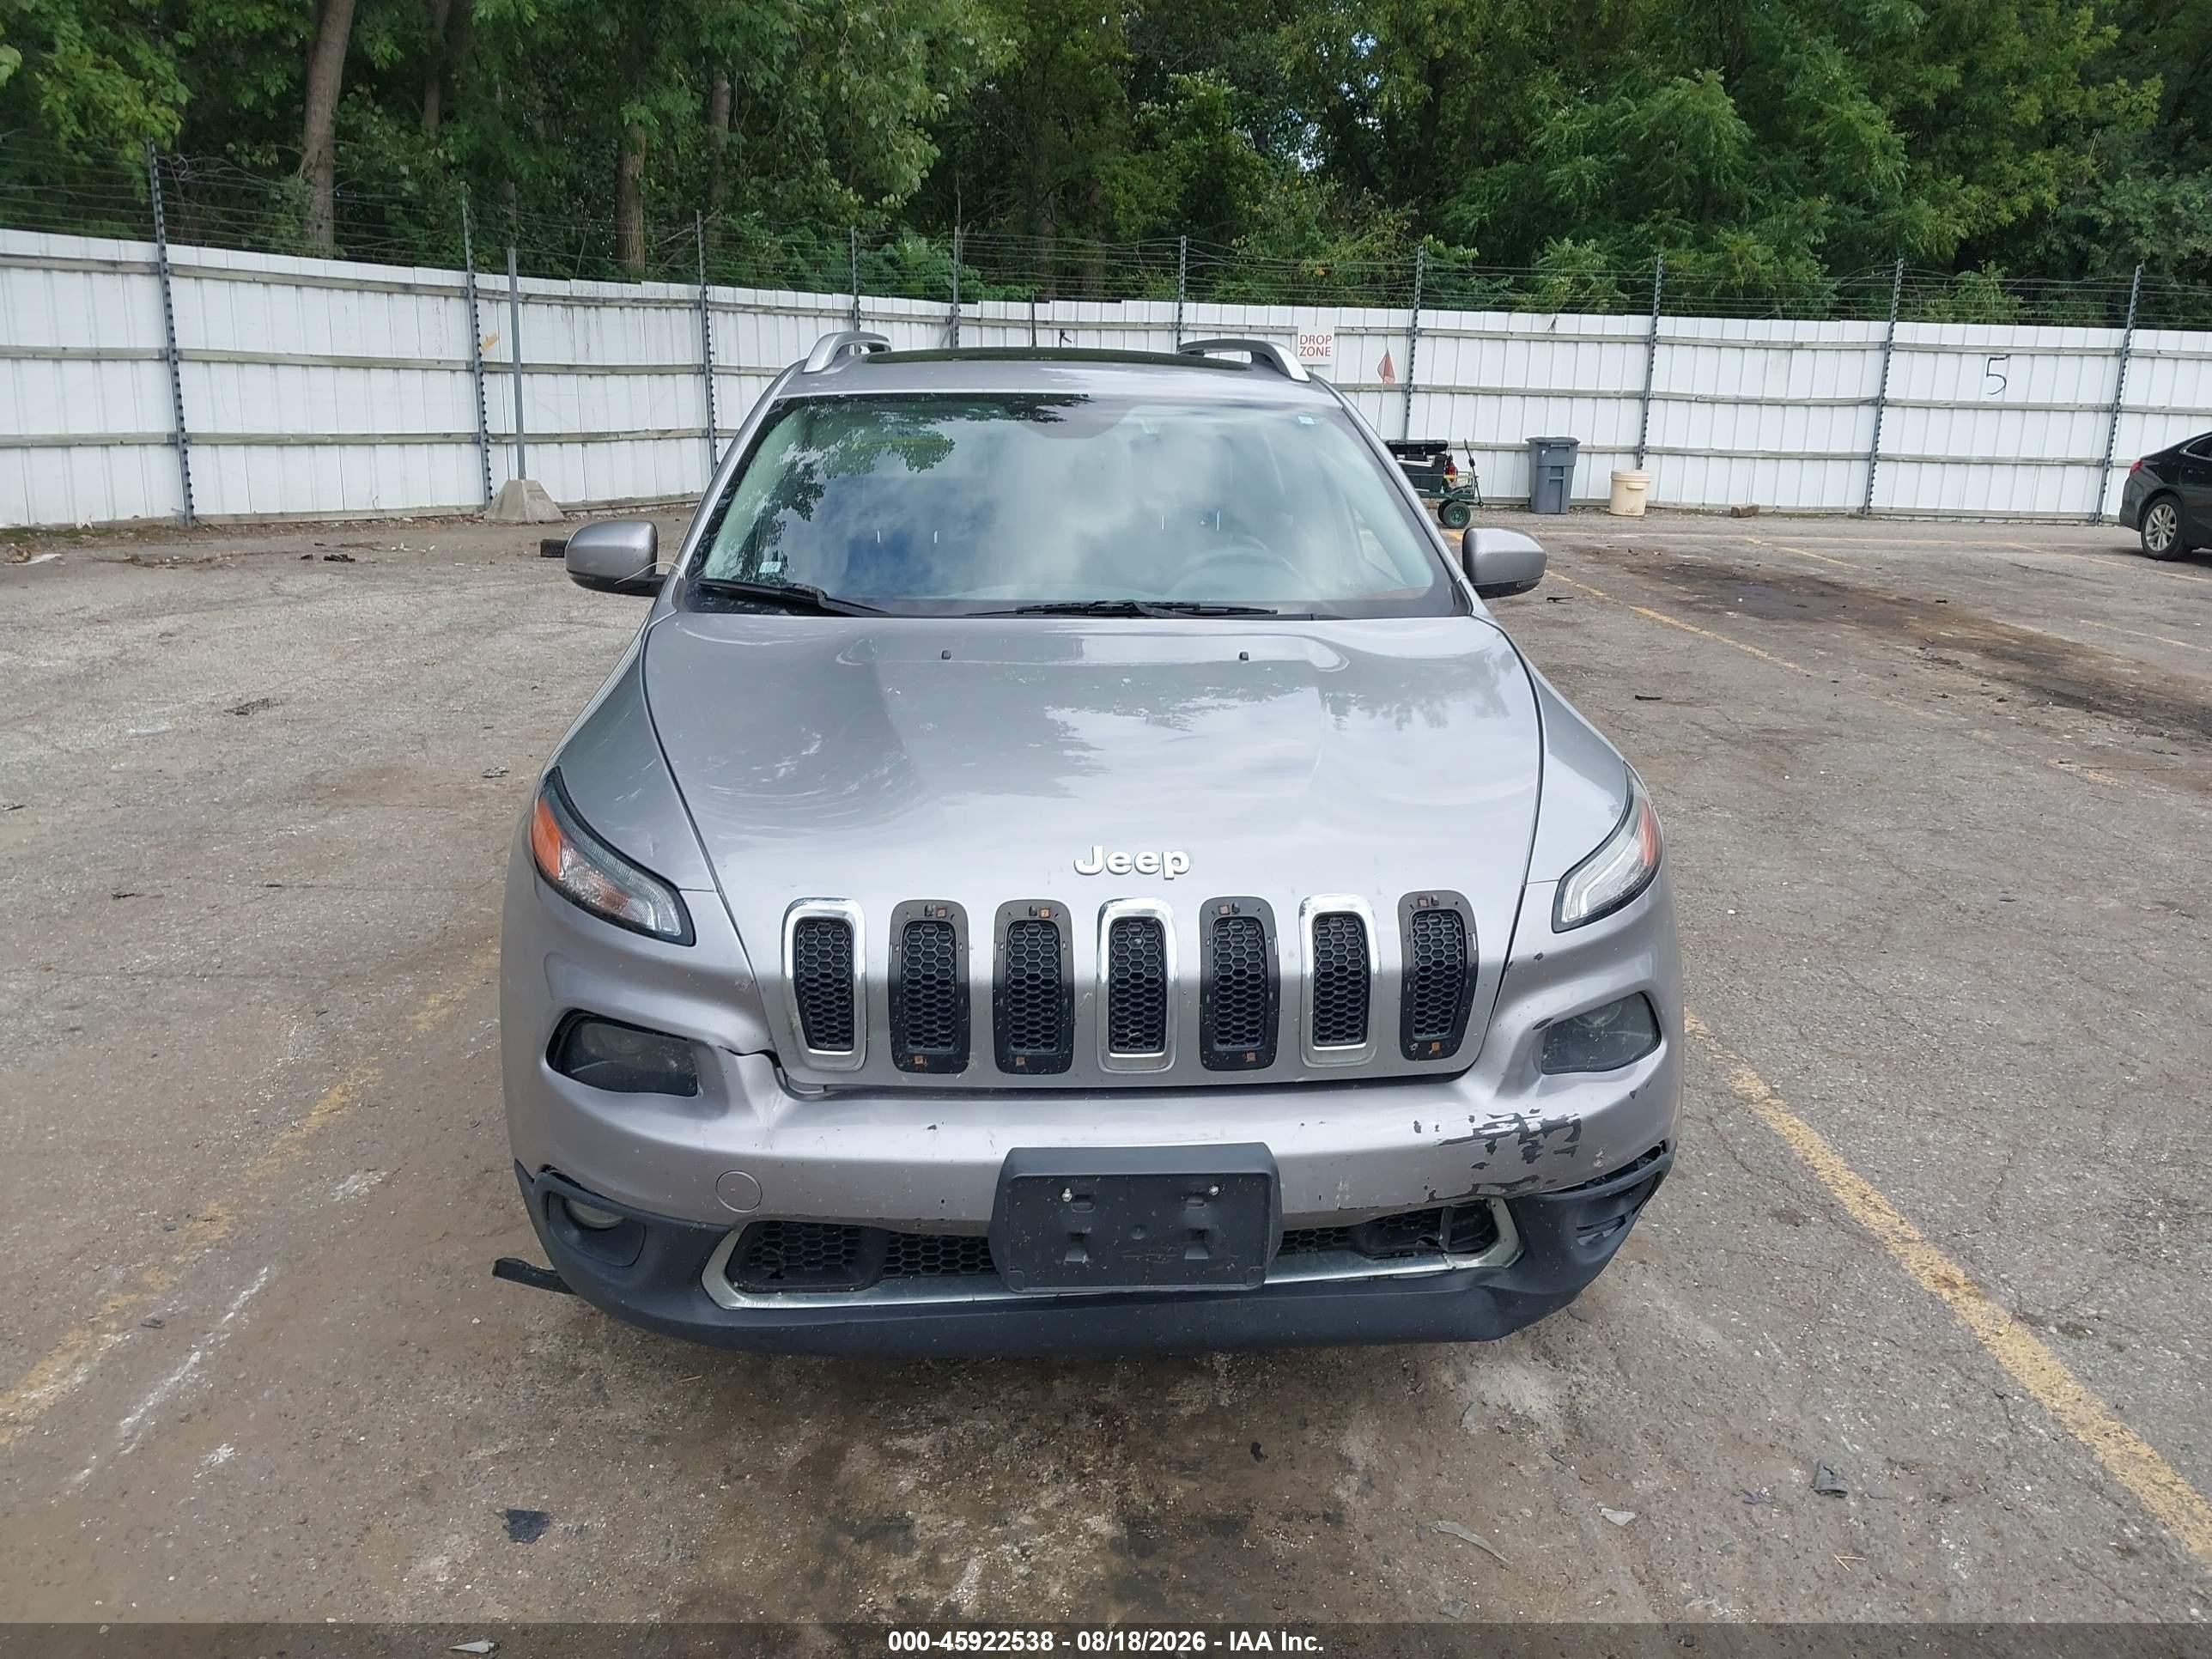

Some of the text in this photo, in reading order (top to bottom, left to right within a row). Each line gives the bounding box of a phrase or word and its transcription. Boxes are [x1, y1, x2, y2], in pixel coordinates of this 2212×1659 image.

[1298, 346, 1332, 356] ZONE
[1299, 334, 1333, 345] DROP
[1985, 355, 2010, 396] 5
[1073, 844, 1191, 880] Jeep
